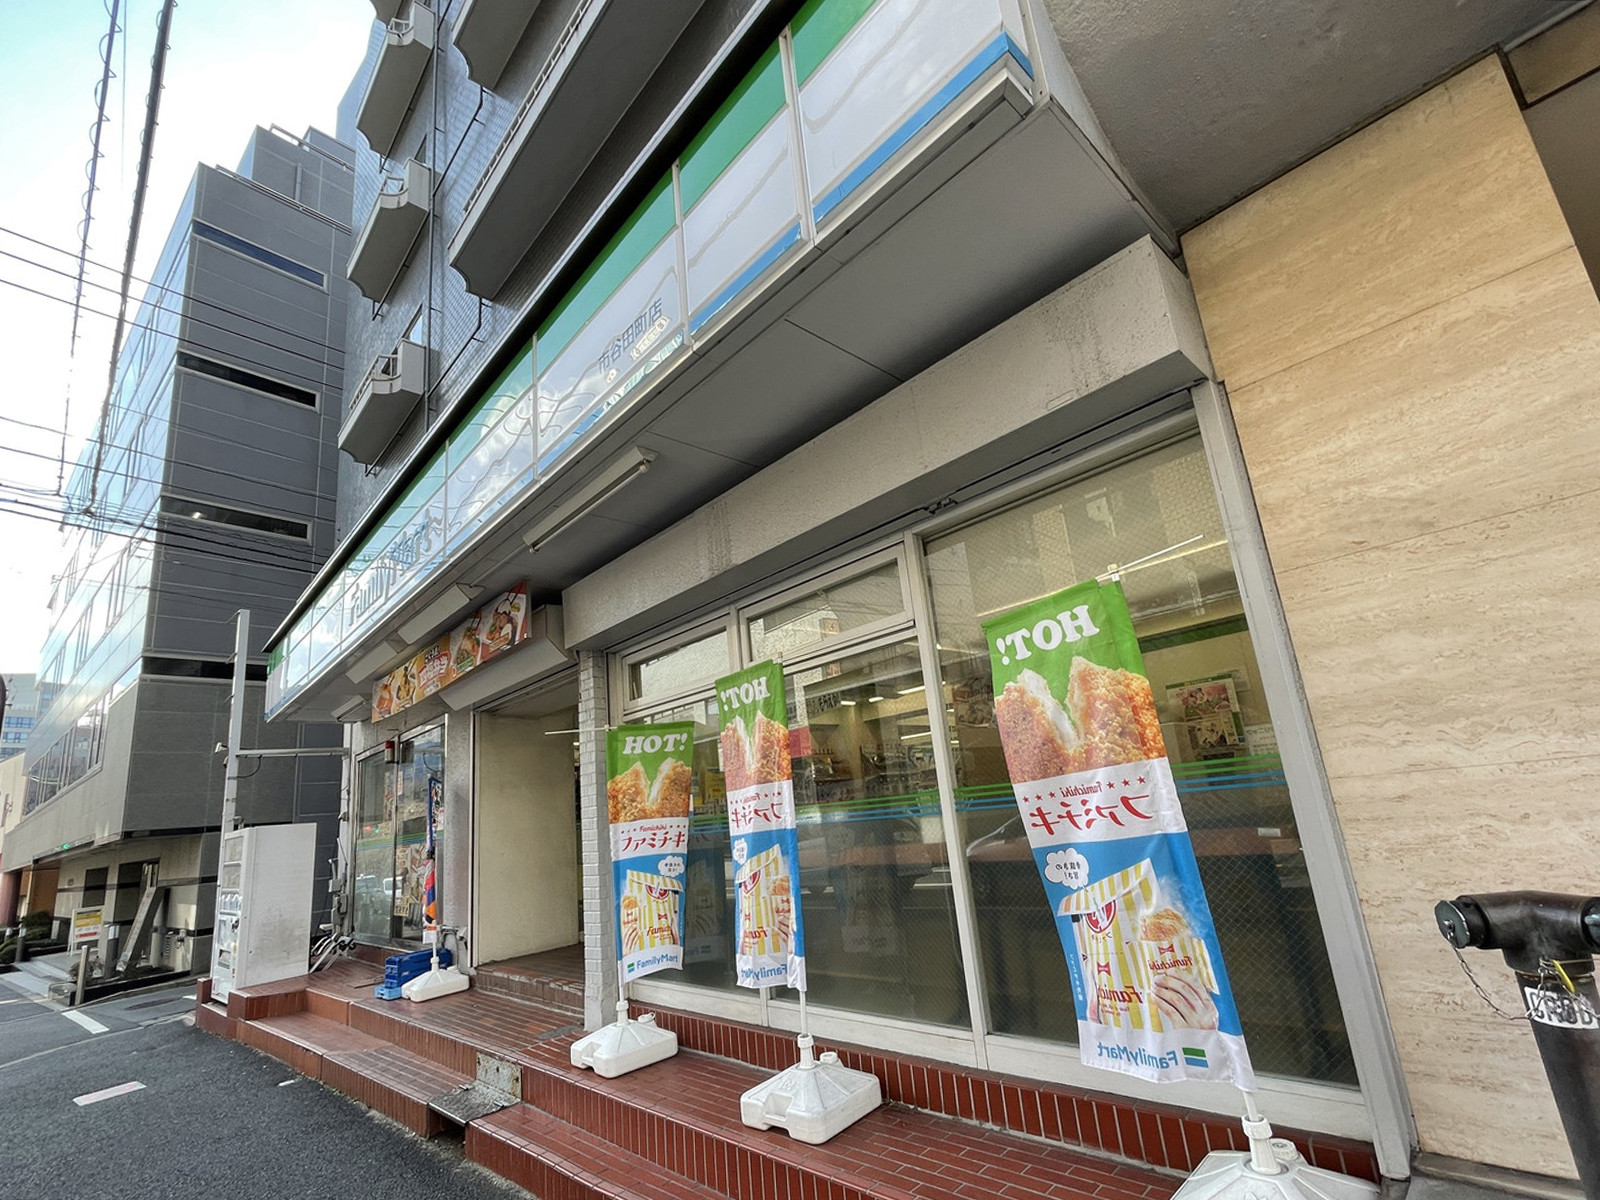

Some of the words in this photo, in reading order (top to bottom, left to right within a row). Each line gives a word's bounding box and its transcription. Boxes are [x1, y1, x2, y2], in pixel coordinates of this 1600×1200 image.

[598, 297, 662, 374] 市谷田町店
[622, 733, 689, 755] HOT!
[620, 831, 686, 853] ファミチキ
[636, 952, 679, 971] FamilyMart
